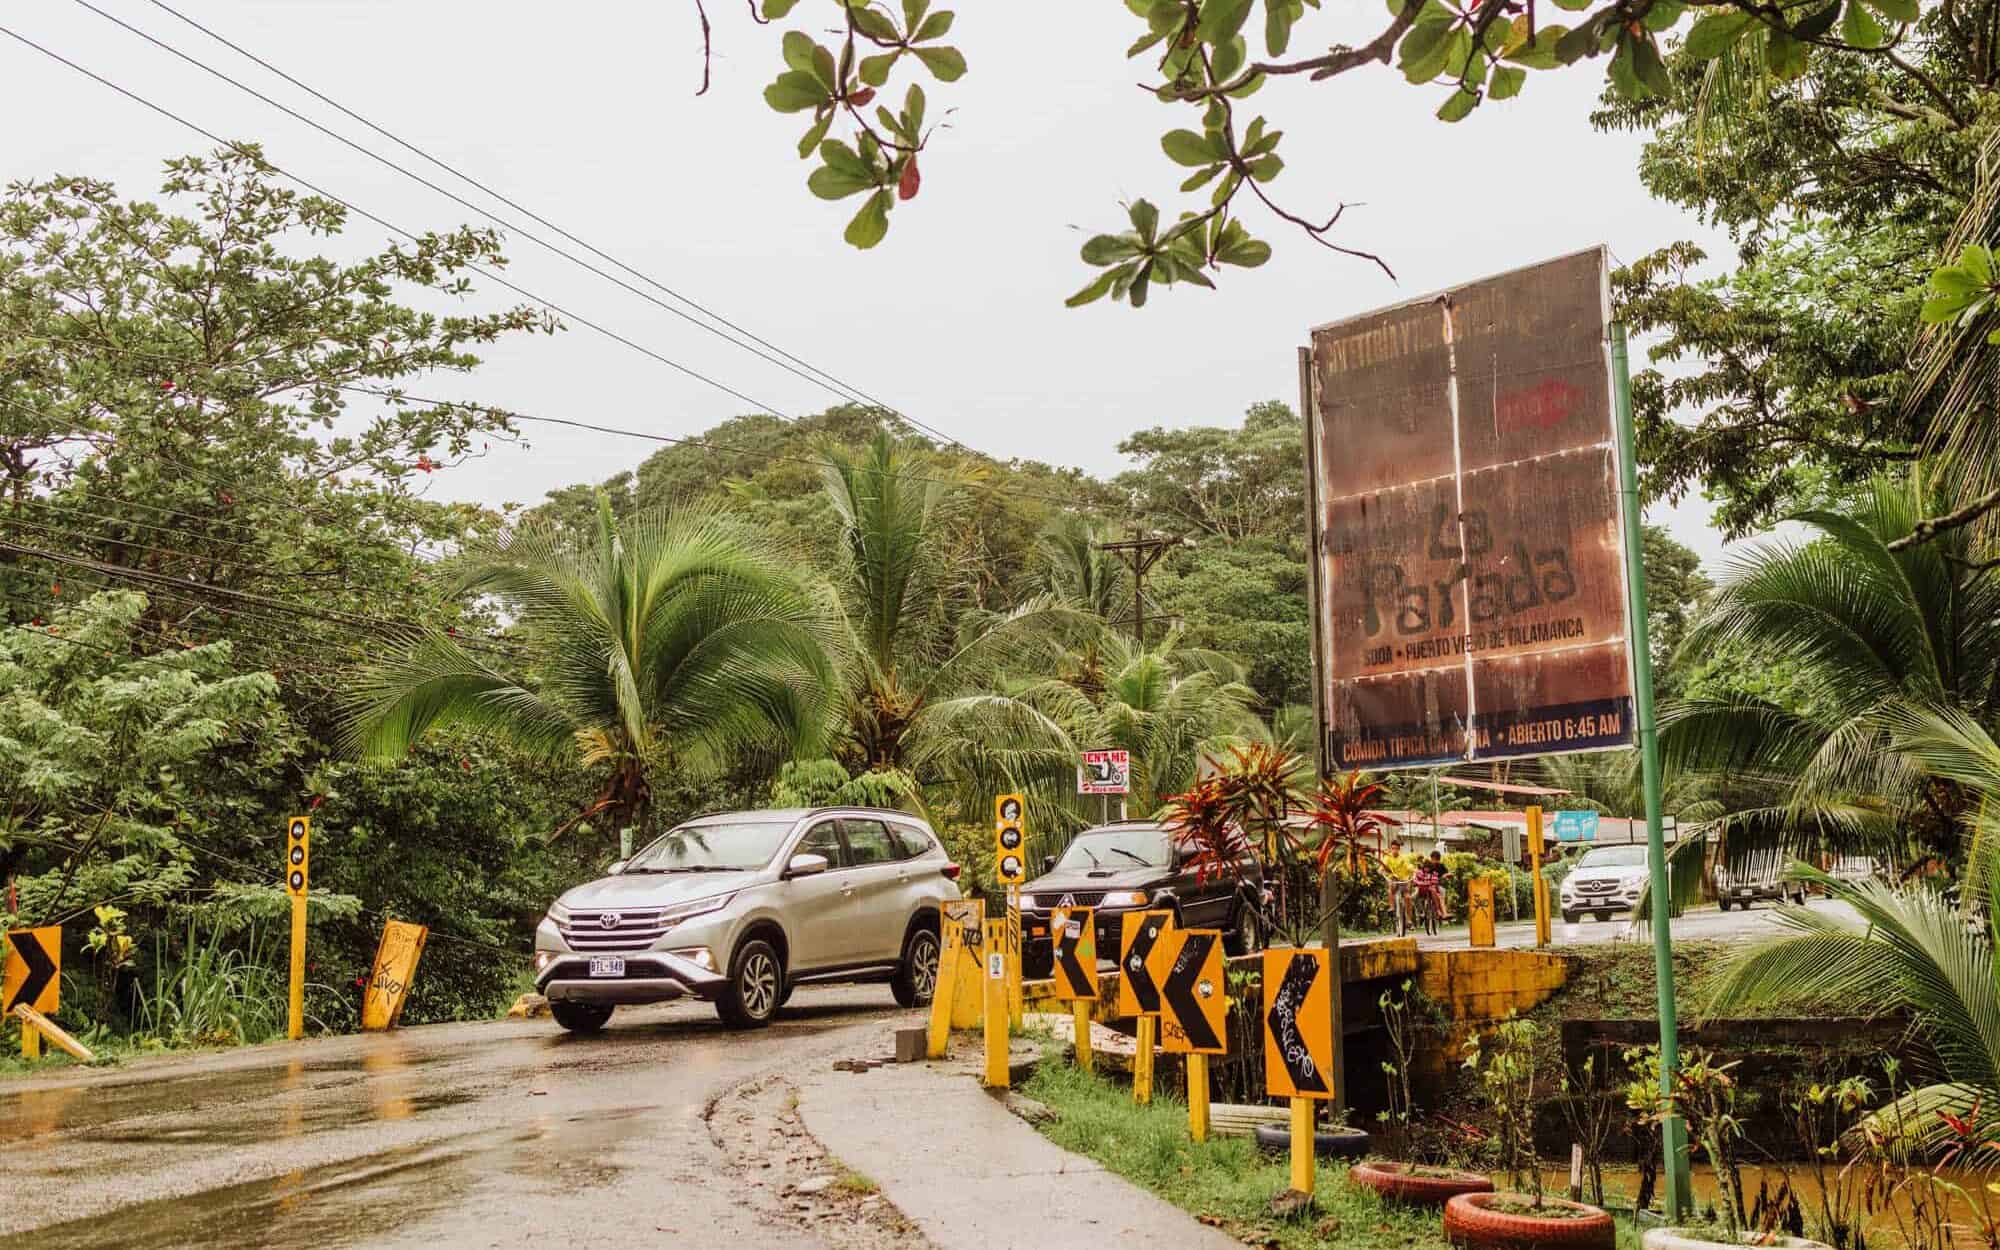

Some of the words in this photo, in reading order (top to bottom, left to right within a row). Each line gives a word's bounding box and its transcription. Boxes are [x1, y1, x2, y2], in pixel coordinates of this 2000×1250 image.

[1429, 503, 1493, 559] La
[1362, 538, 1577, 637] Parada
[1405, 636, 1450, 663] PUERTO
[1489, 630, 1505, 649] DE
[1508, 617, 1585, 646] TALAMANCA
[1111, 751, 1127, 762] ME
[1343, 740, 1386, 762] COMIDA
[1389, 735, 1426, 758] TIPICA
[1508, 719, 1562, 745] ABIERTO
[1564, 715, 1596, 740] 6:45
[1599, 712, 1621, 736] AM
